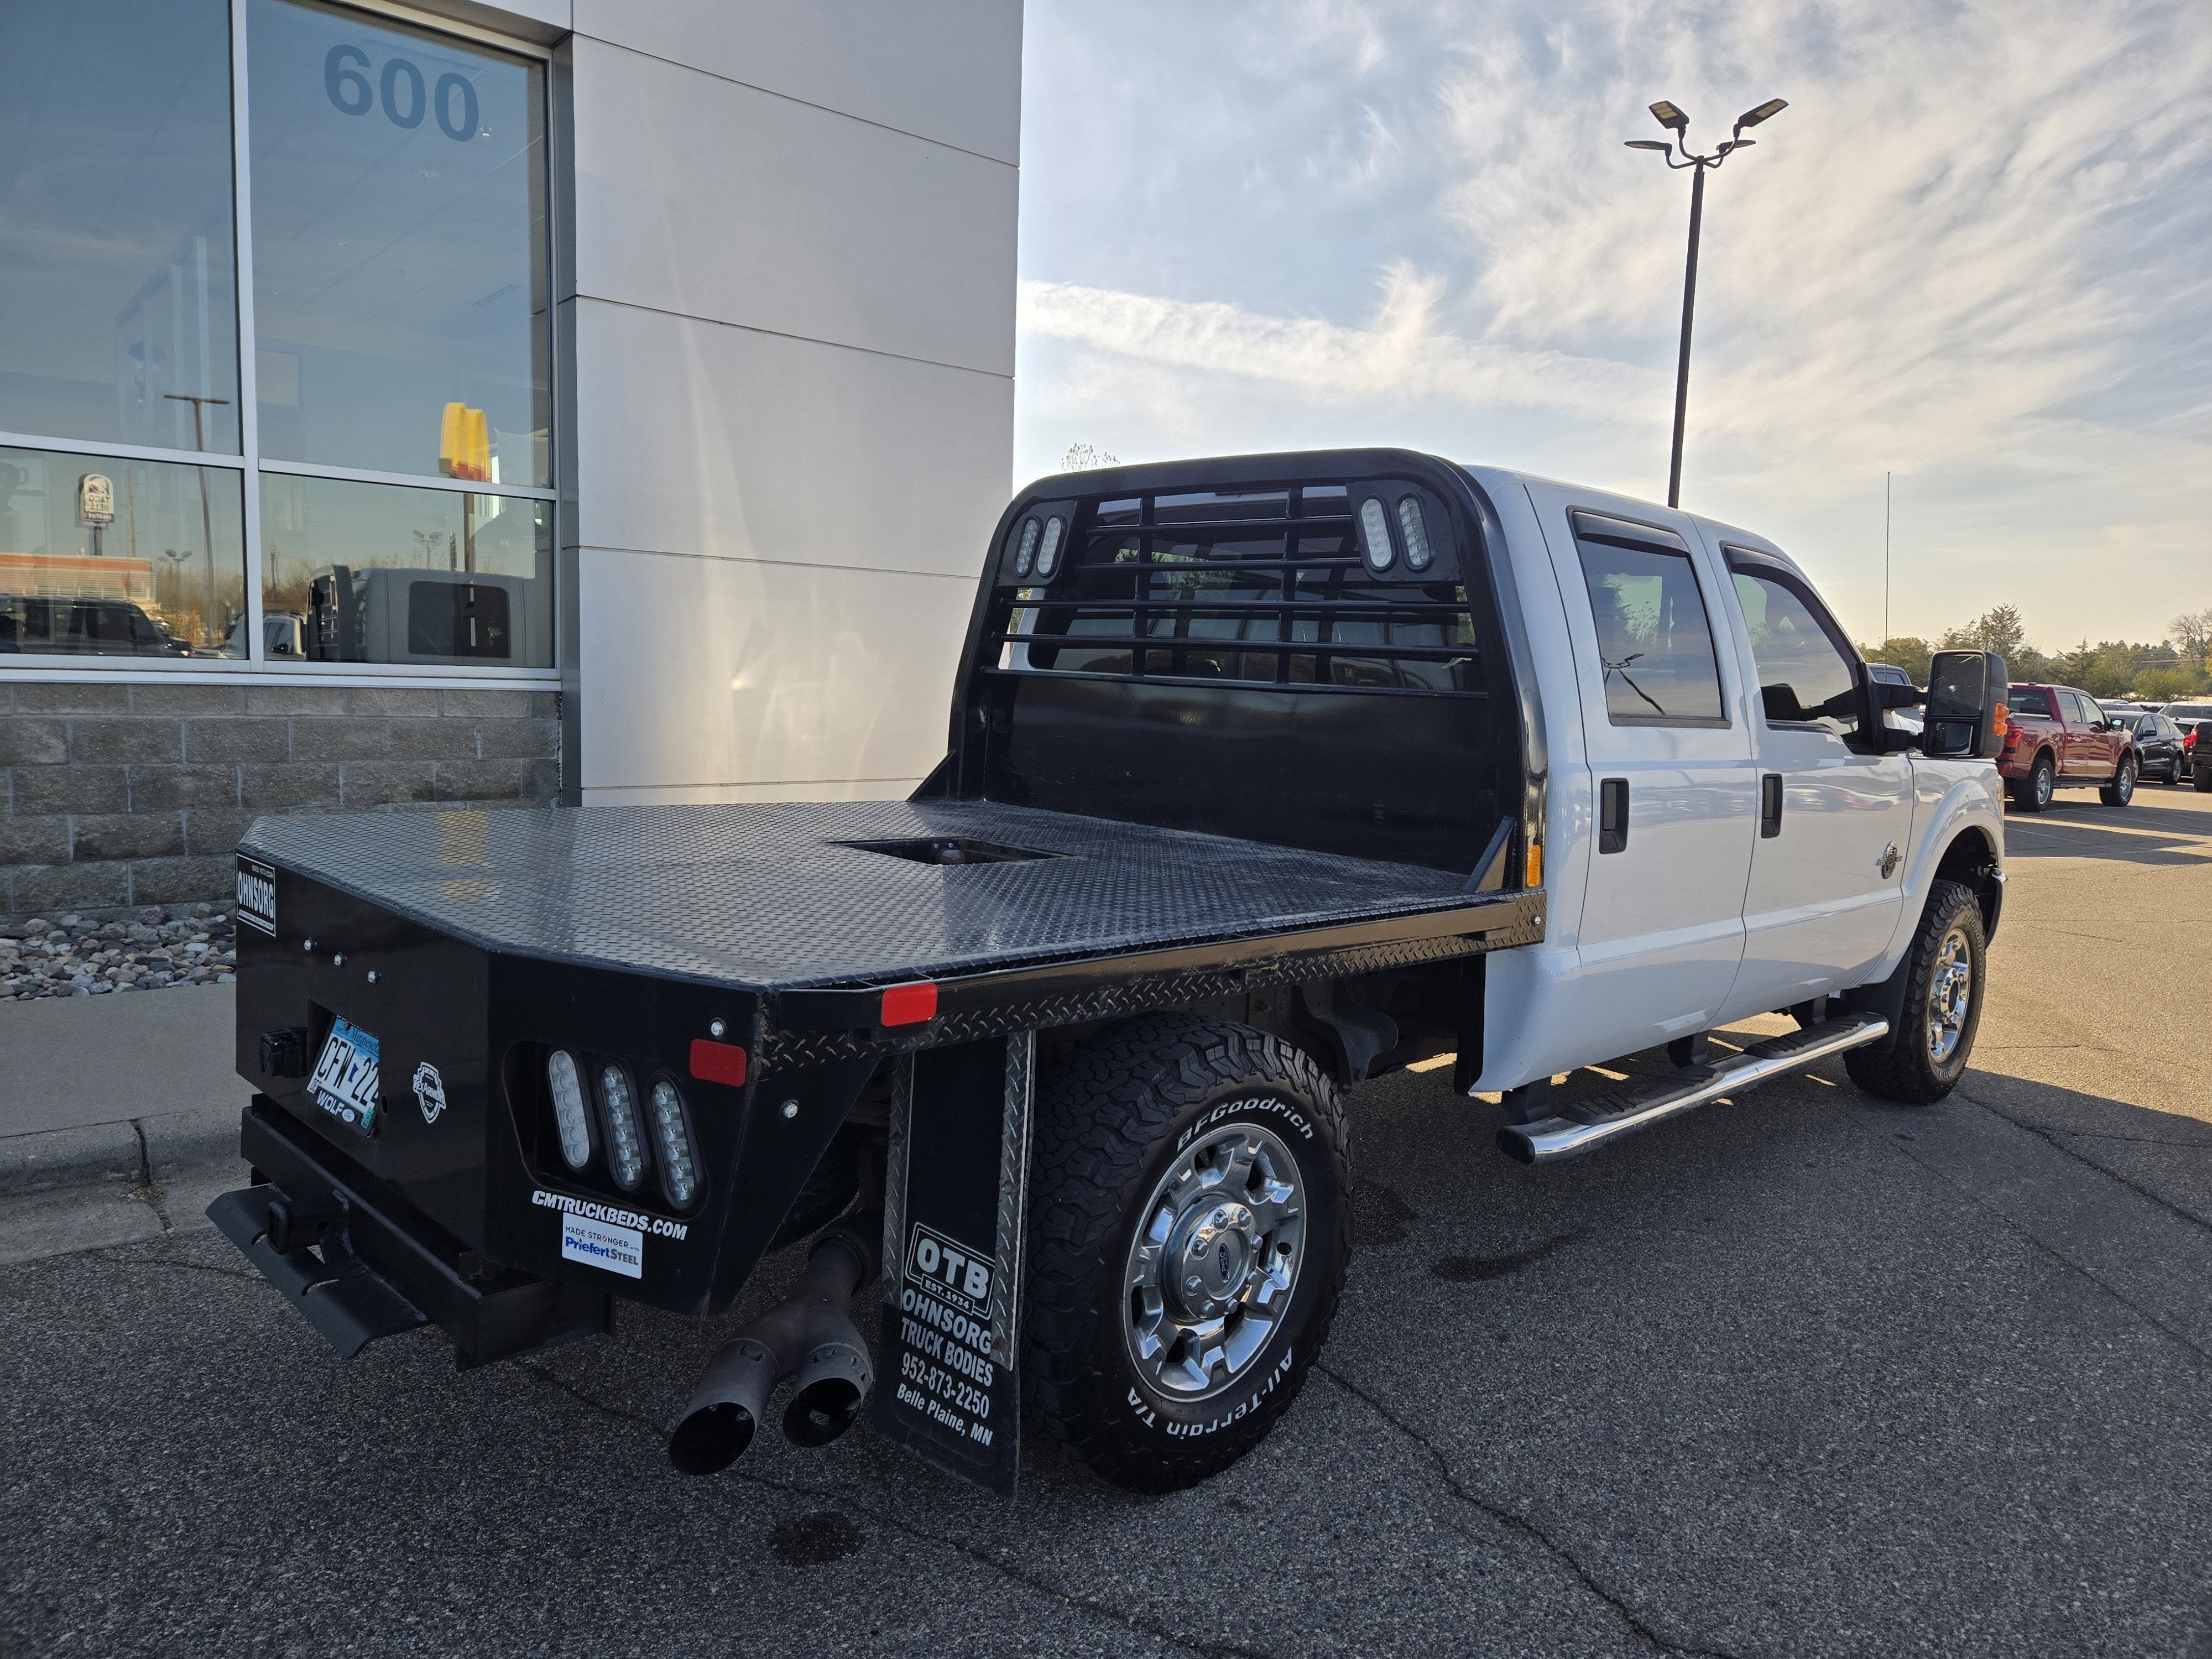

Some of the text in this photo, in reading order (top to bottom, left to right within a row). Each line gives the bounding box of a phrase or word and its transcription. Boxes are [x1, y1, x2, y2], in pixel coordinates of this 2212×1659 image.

[325, 44, 479, 142] 600
[238, 870, 274, 919] OHNSORG
[317, 1037, 356, 1089] CFW
[316, 1090, 345, 1116] WOLF
[1177, 1097, 1313, 1151] BFGoodrich
[531, 1190, 688, 1240] CMTRUCKBEDS.COM
[565, 1226, 586, 1237] MADE
[917, 1238, 989, 1299] OTB
[925, 1280, 969, 1309] EST. 1934
[902, 1288, 991, 1354] OHNSORG
[901, 1317, 993, 1386] TRUCK BODIES
[901, 1352, 989, 1418] 952-873-2250
[1127, 1347, 1292, 1439] All-Terrain T/A
[896, 1383, 993, 1446] Belle Plaine, MN
